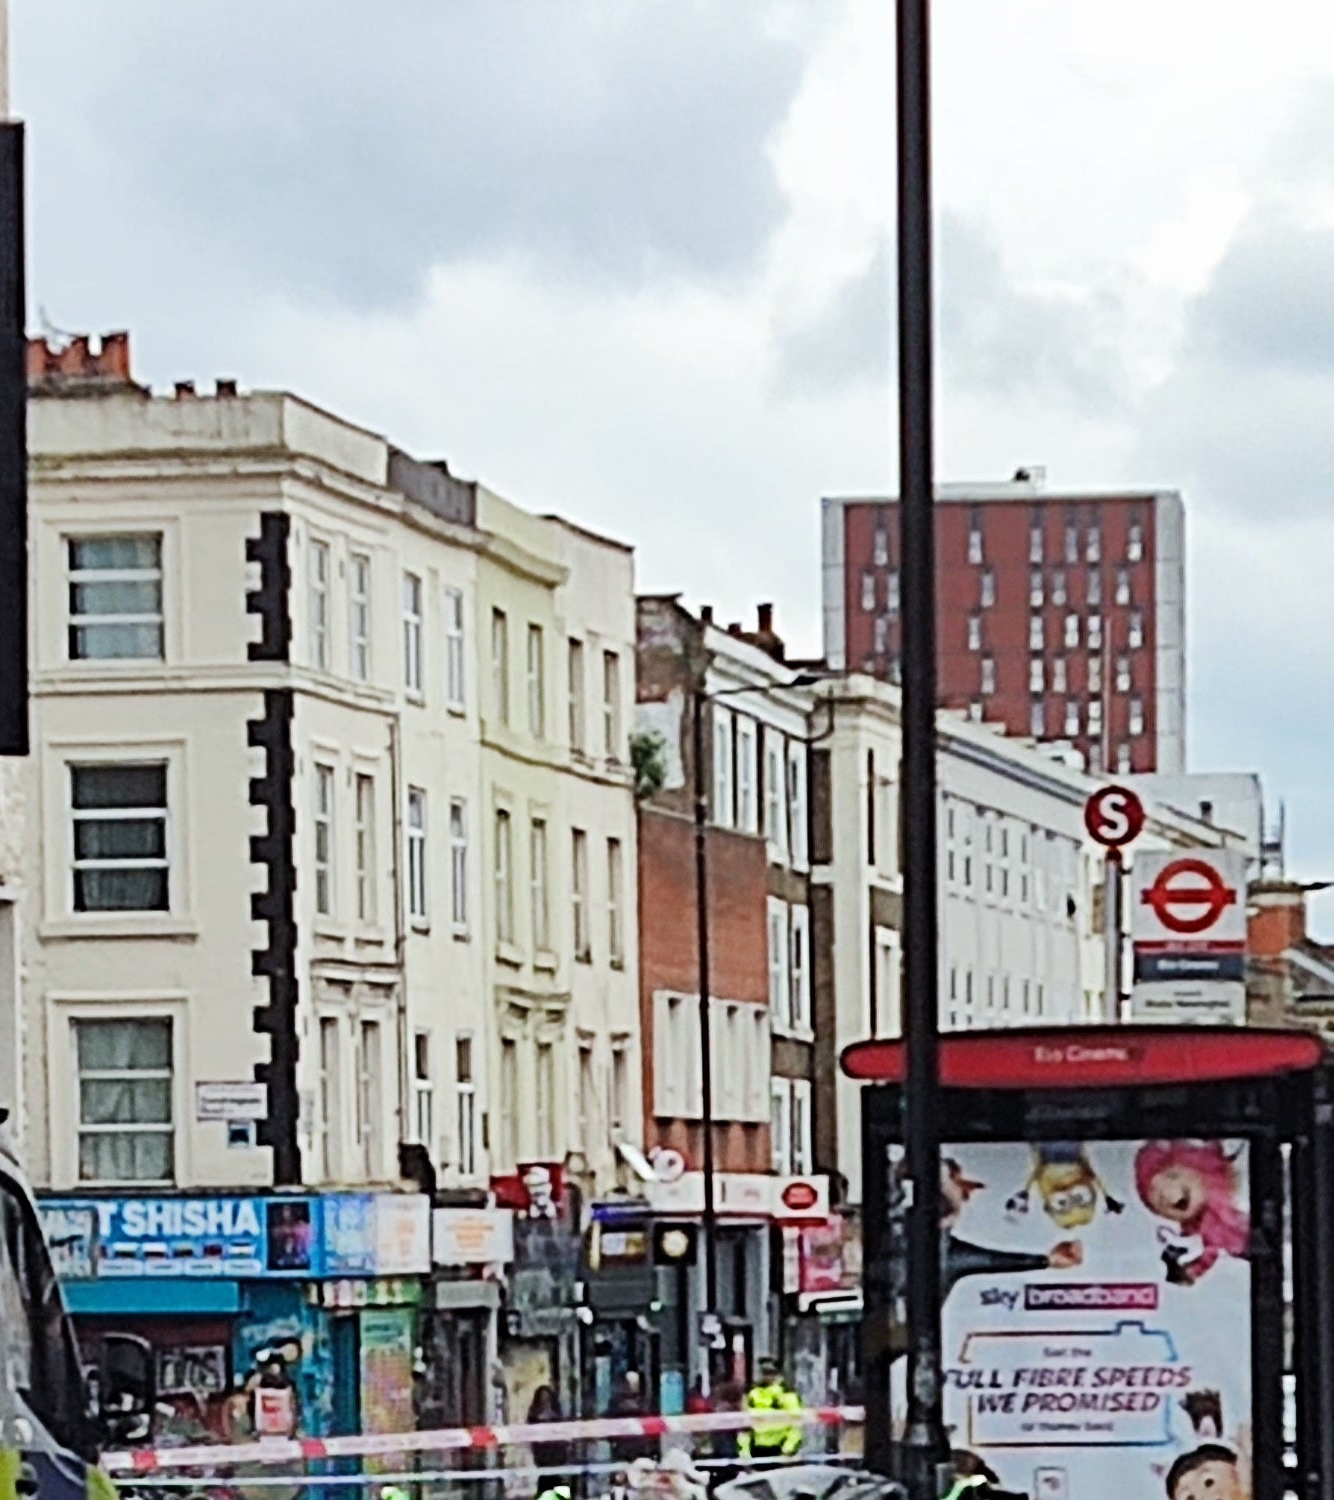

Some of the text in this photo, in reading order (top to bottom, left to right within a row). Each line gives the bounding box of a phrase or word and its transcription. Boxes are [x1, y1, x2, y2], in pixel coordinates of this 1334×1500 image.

[1098, 793, 1131, 839] S
[121, 1200, 260, 1237] SHISHA
[1027, 1286, 1156, 1307] broadband
[1012, 1367, 1087, 1389] FIBRE
[1092, 1366, 1194, 1389] SPEEDS
[977, 1391, 1161, 1415] WE PROMISED
